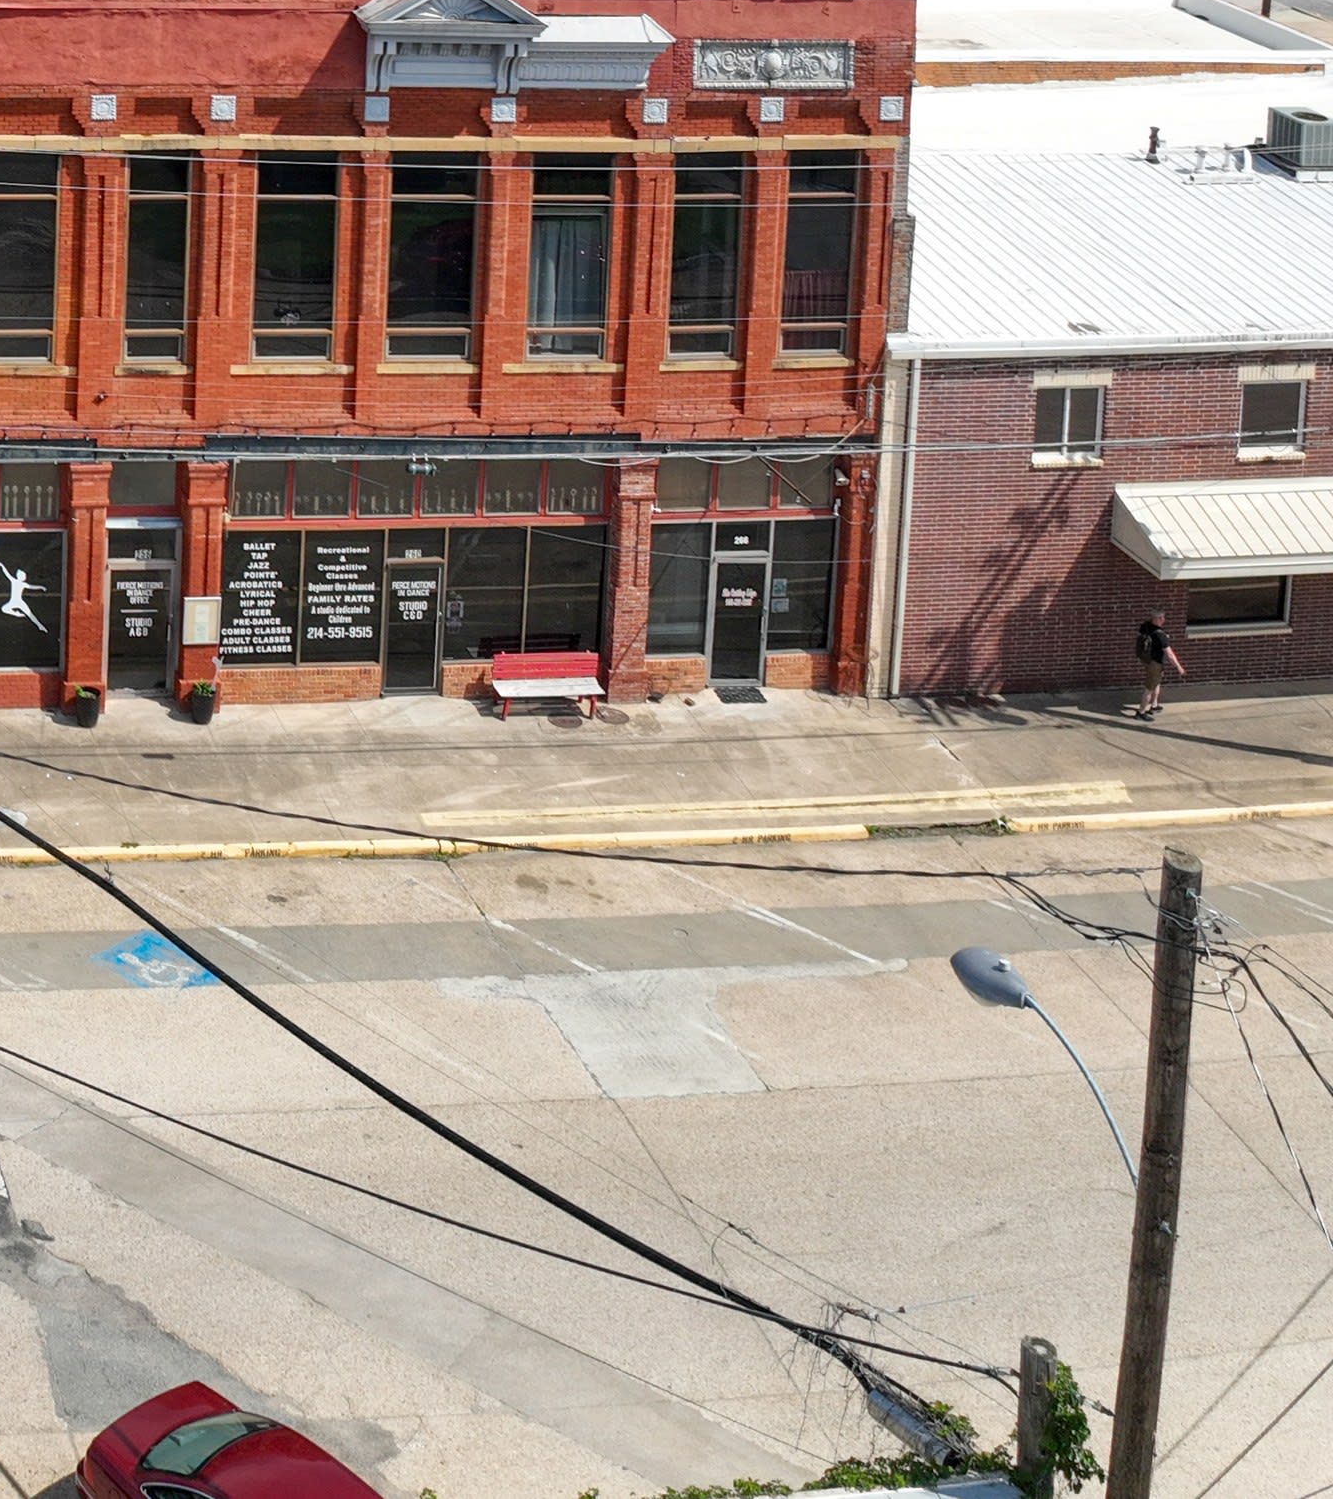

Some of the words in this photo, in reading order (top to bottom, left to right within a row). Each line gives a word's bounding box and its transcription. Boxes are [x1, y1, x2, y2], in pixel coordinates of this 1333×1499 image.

[243, 543, 276, 551] BALLET
[317, 546, 370, 554] Recreational
[251, 552, 268, 560] TAP
[317, 563, 368, 572] Competitive
[325, 572, 358, 580] Classes
[229, 581, 283, 589] ACROBATICS
[392, 581, 410, 590] FIERCE
[410, 581, 436, 589] MOTIONS
[240, 590, 276, 598] LYRICAL
[397, 589, 406, 597] IN
[406, 589, 430, 597] DANCE
[307, 595, 341, 603] FAMILY
[240, 600, 255, 608] HIP
[257, 599, 276, 607] HOP
[398, 601, 428, 611] STUDIO
[335, 605, 363, 614] dedicated
[125, 617, 153, 628] STUDIO
[233, 618, 281, 626] PRE-DANCE
[328, 614, 352, 624] Children
[221, 628, 252, 636] COMBO
[307, 626, 373, 639] 214-551-9515
[222, 637, 251, 645] ADULT
[252, 636, 290, 644] CLASSES
[219, 646, 254, 654] FITNESS
[255, 645, 292, 653] CLASSES
